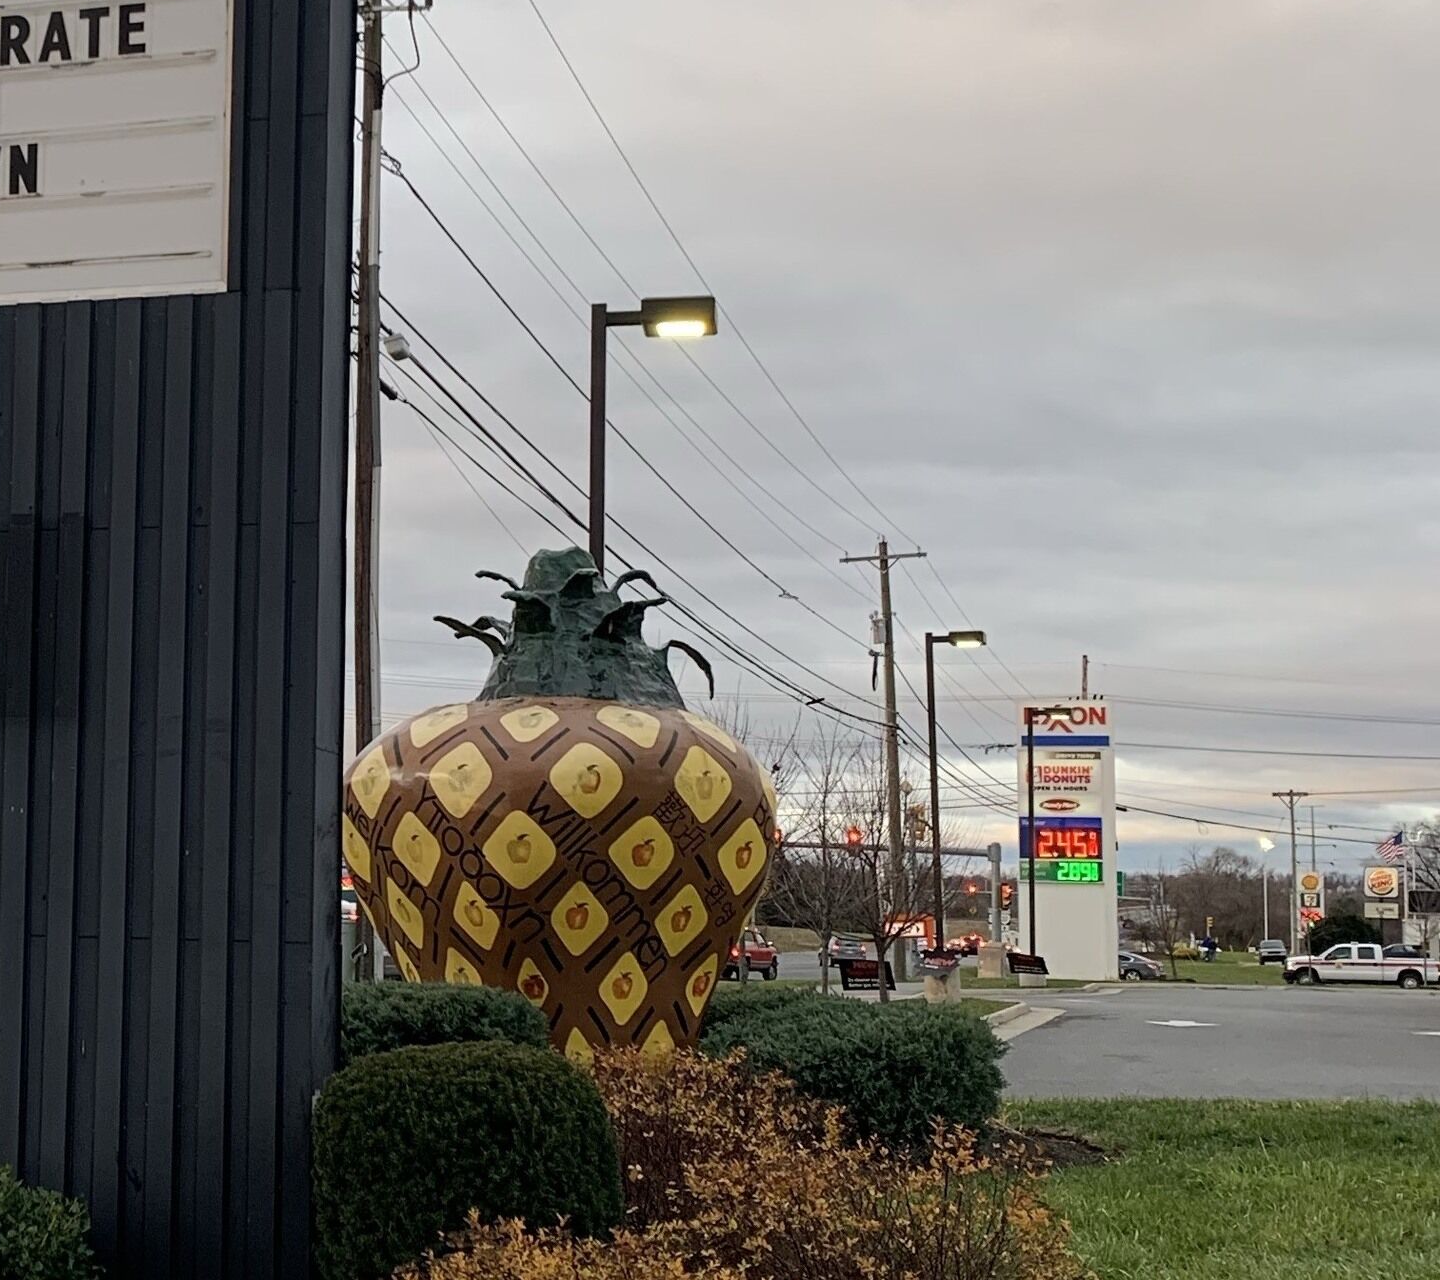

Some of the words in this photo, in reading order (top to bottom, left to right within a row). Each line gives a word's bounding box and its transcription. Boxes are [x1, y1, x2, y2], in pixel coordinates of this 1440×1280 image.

[0, 3, 147, 66] RATE
[1043, 775, 1091, 784] DONUTS
[527, 780, 668, 984] Willkommen
[1371, 879, 1393, 889] KING
